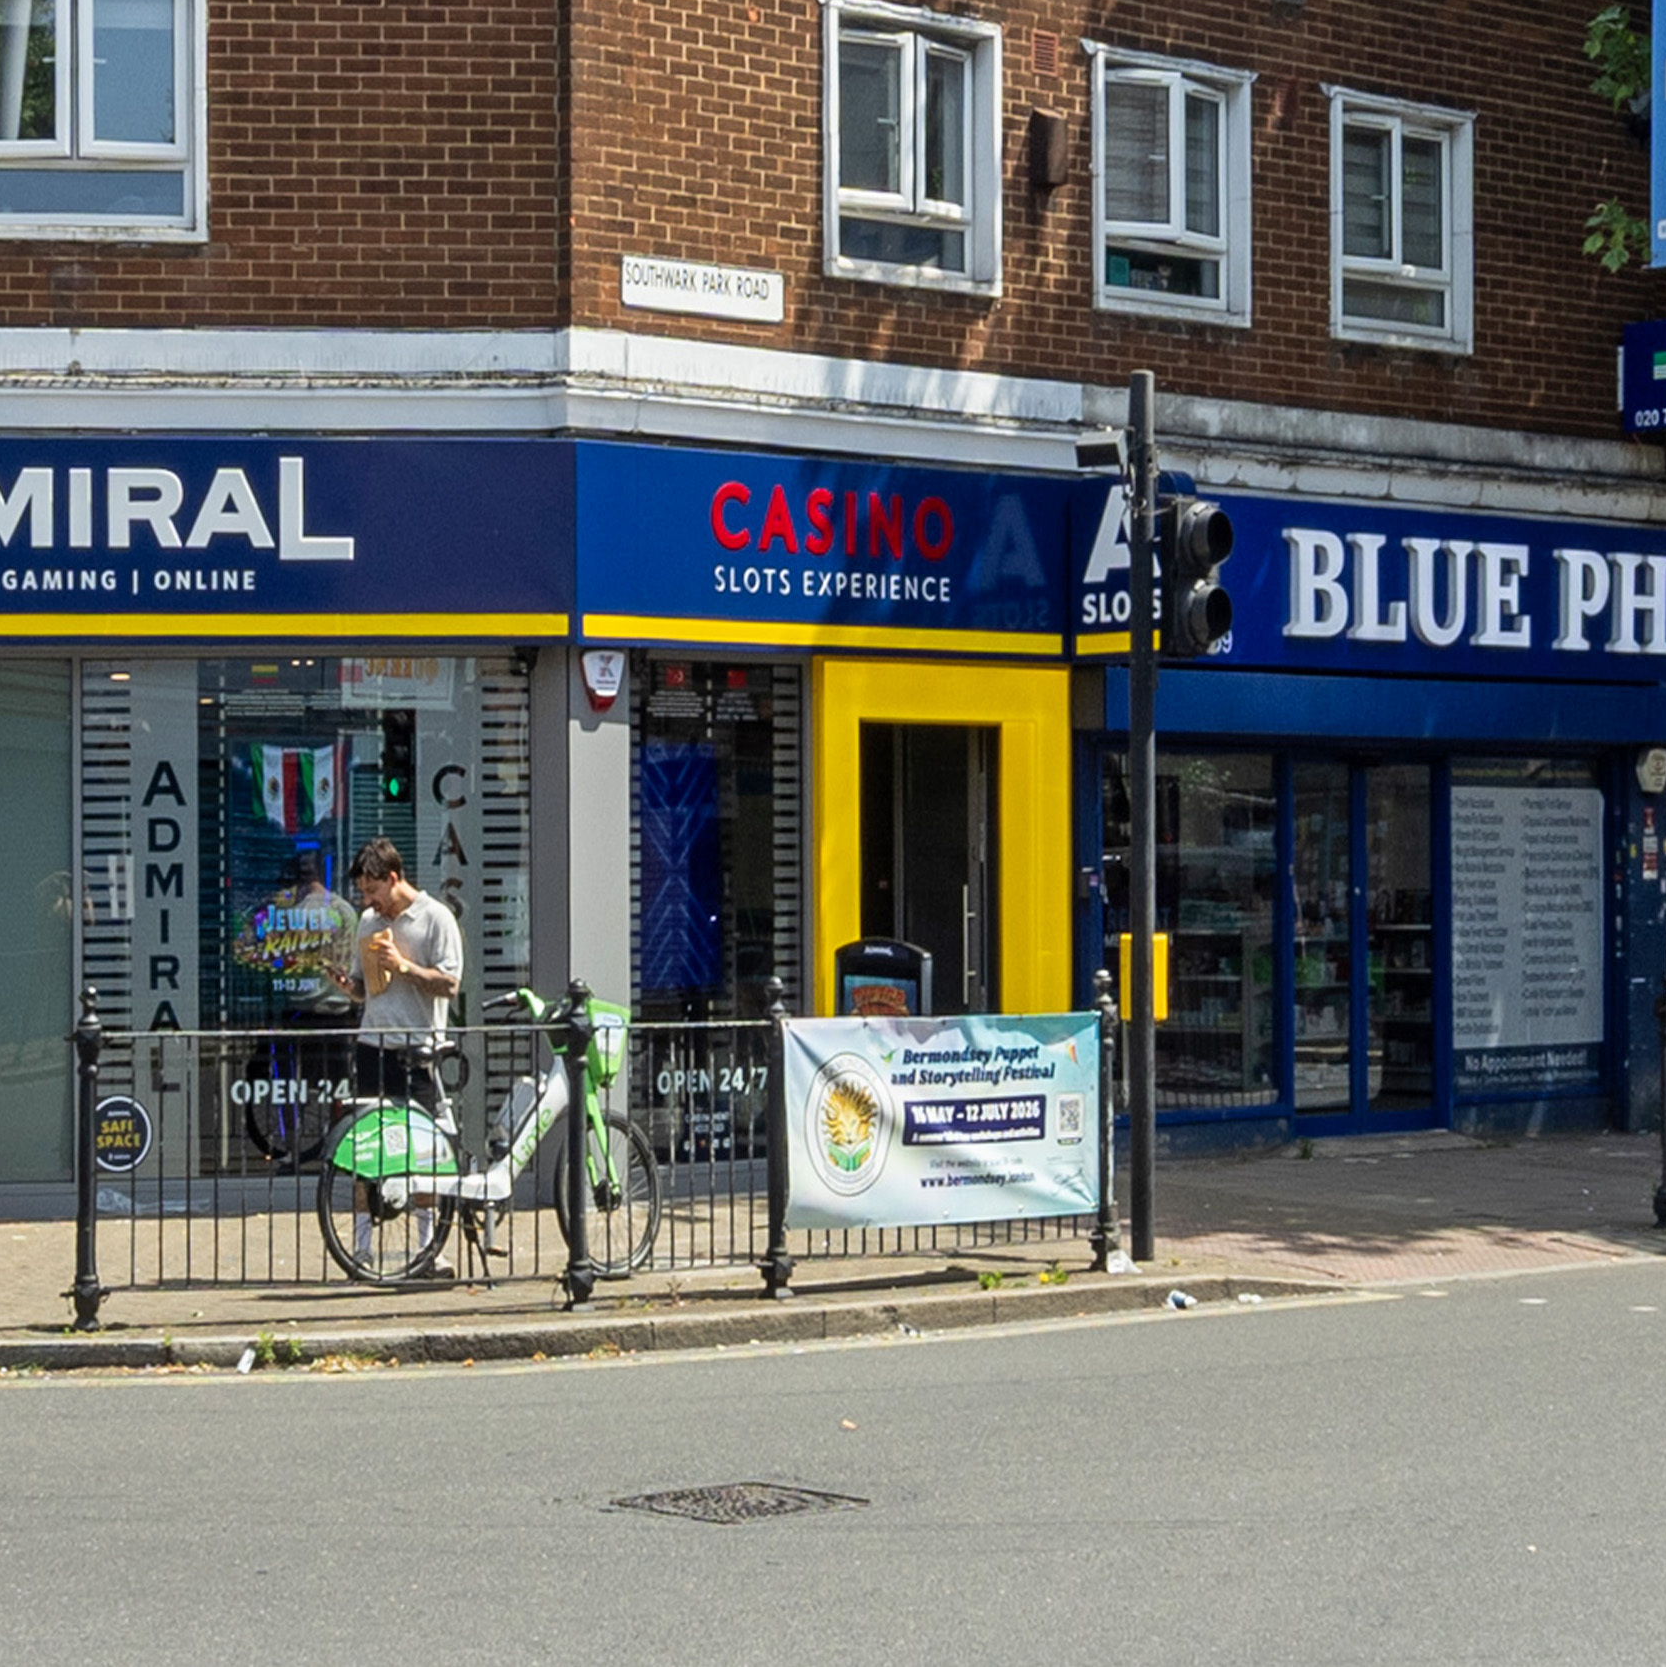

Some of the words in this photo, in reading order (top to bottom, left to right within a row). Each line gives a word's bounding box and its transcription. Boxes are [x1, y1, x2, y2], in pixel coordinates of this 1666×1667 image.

[625, 262, 697, 292] SOUTHWARK
[702, 272, 731, 296] PARK
[737, 276, 770, 300] ROAD
[1635, 409, 1659, 427] 020
[710, 480, 954, 563] CASINO
[2, 569, 118, 591] GAMING
[153, 569, 257, 591] ONLINE
[713, 565, 791, 595] SLOTS
[802, 569, 951, 602] EXPERIENCE
[1281, 527, 1531, 650] BLUE
[1082, 588, 1162, 624] SLOS
[903, 1046, 992, 1065] Bermondsey
[995, 1045, 1039, 1063] Puppet
[1481, 1053, 1546, 1074] Appointment
[657, 1069, 712, 1094] OPEN
[719, 1066, 768, 1096] 24/7
[891, 1069, 916, 1084] and
[919, 1066, 1002, 1087] Storytelling
[1003, 1063, 1055, 1081] Festival
[230, 1078, 307, 1105] OPEN
[965, 1104, 978, 1122] 12
[980, 1103, 1009, 1121] JULY
